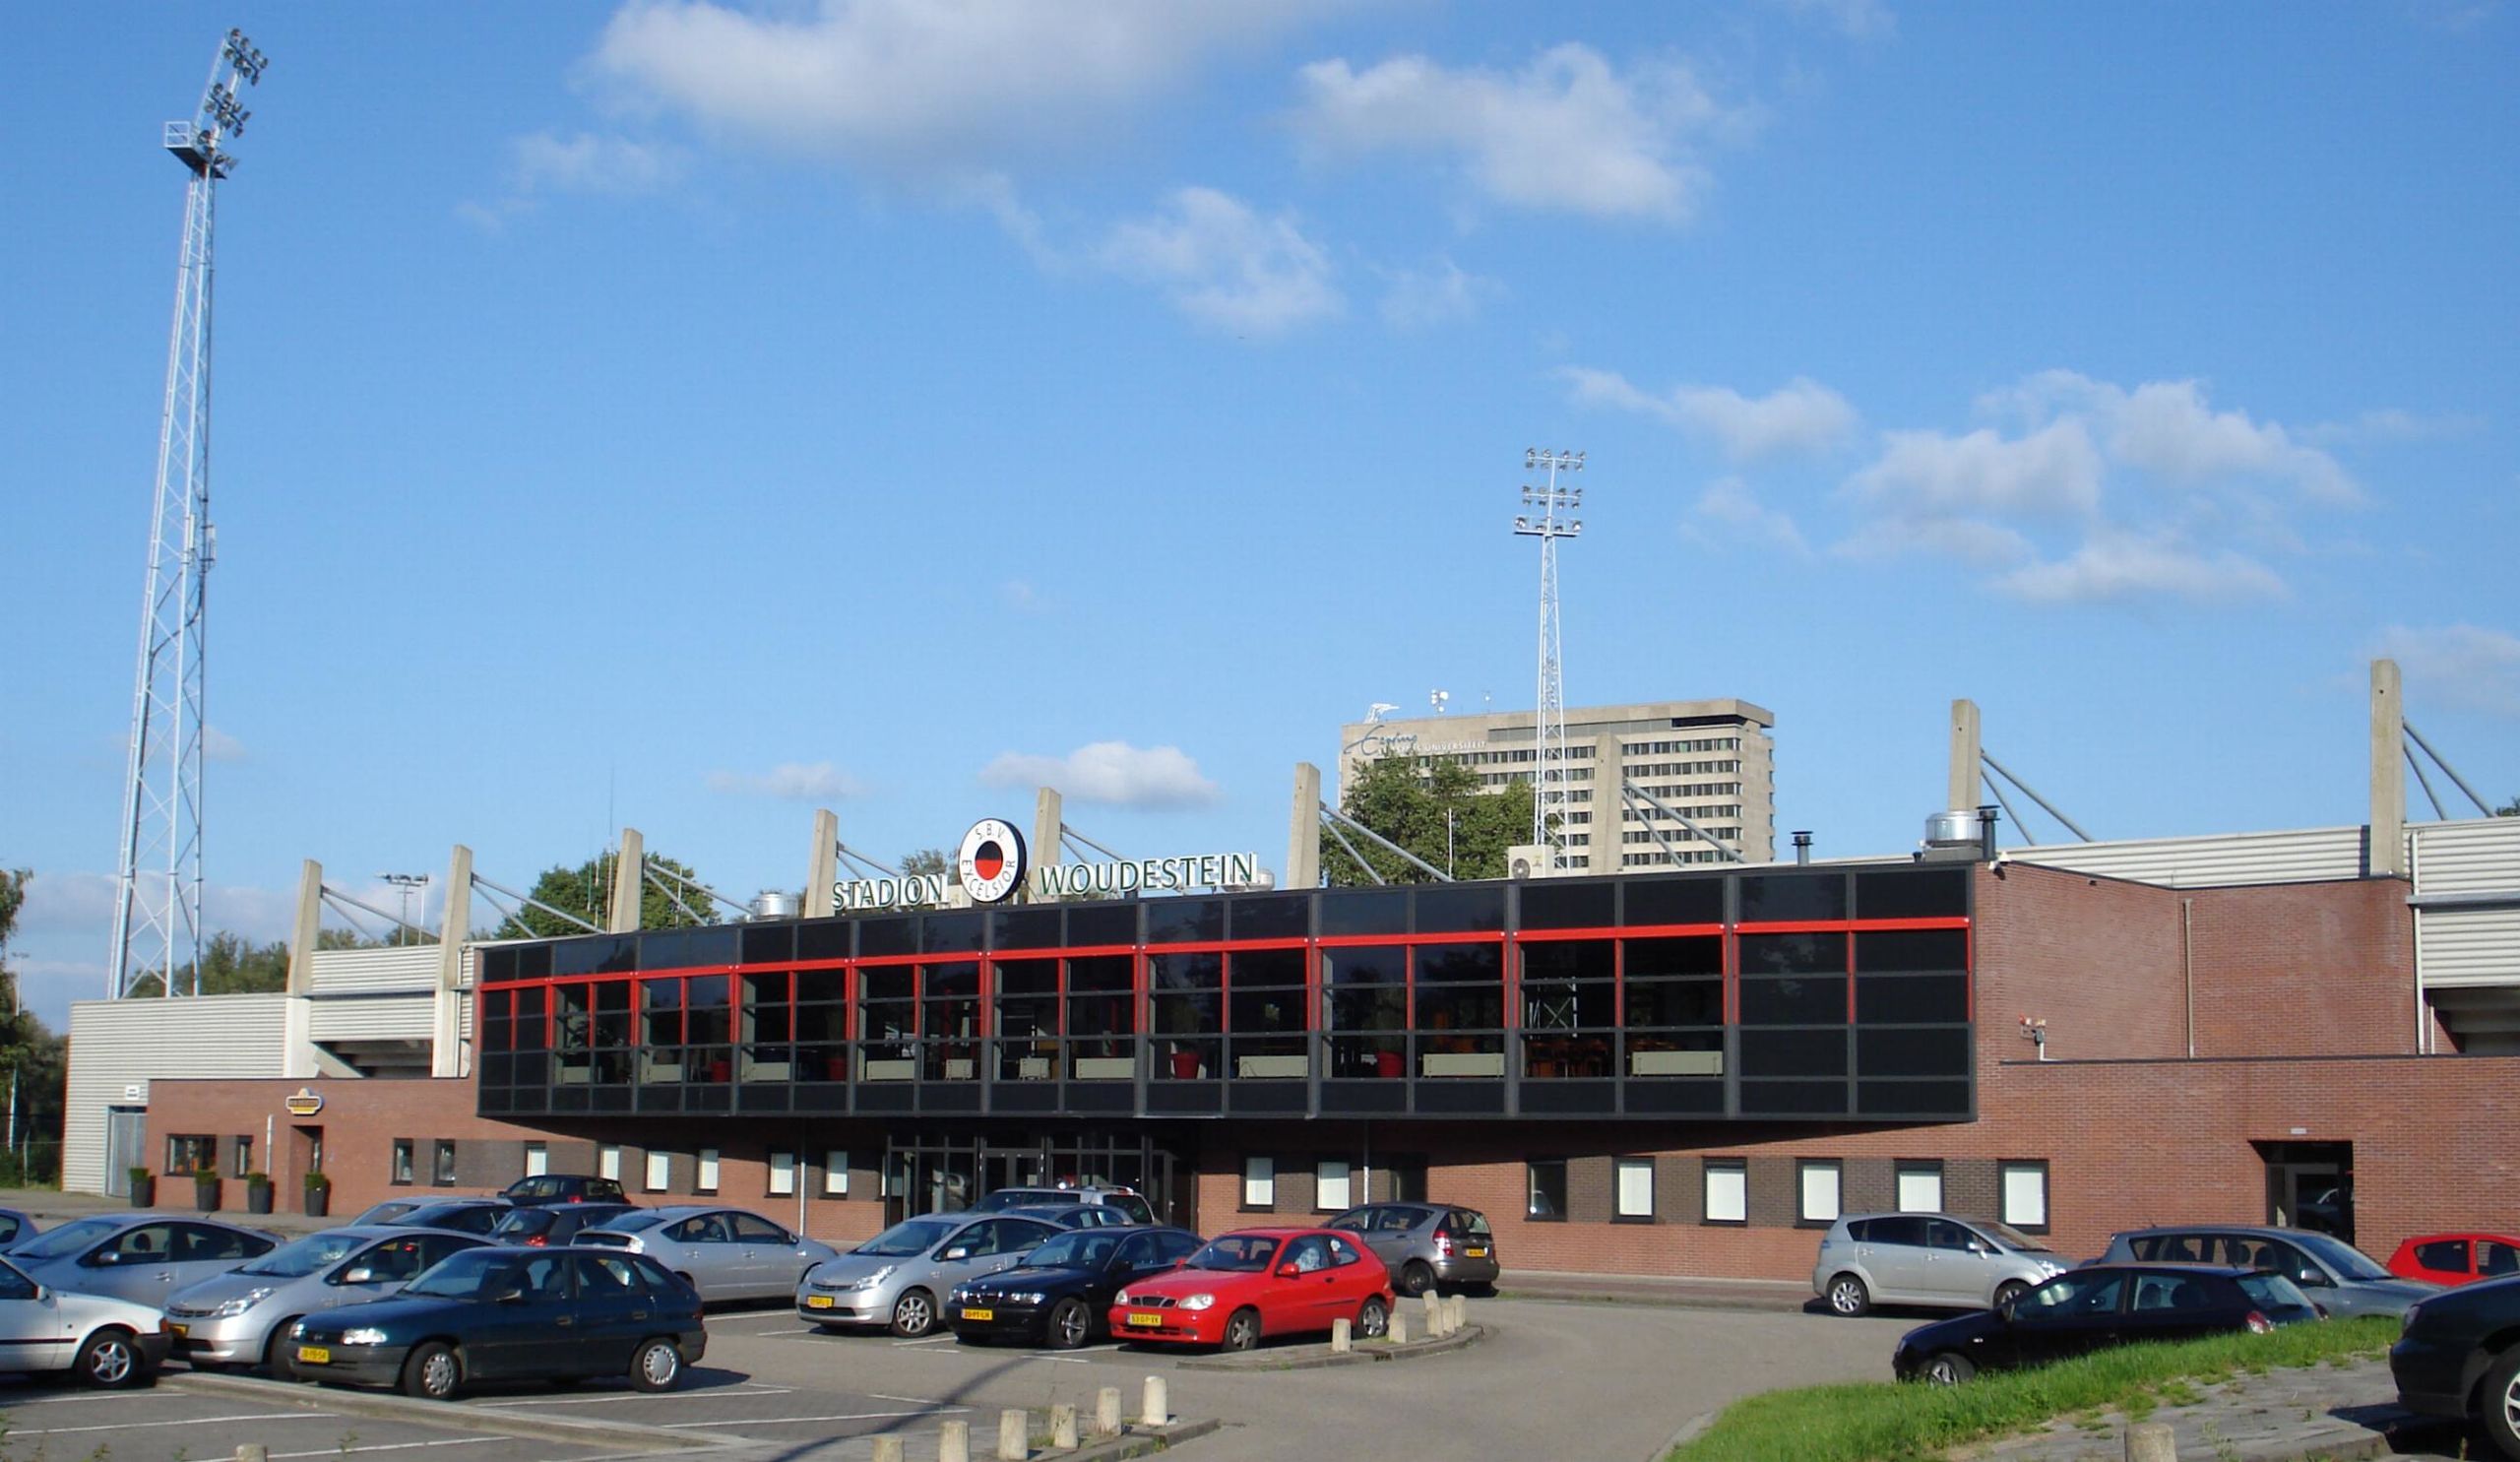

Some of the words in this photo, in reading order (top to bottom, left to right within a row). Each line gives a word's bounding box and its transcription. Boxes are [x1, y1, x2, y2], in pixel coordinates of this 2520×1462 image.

[831, 872, 946, 910] STADION
[1039, 852, 1255, 895] WOUDESTEIN
[962, 859, 1016, 898] EXCELSIOR
